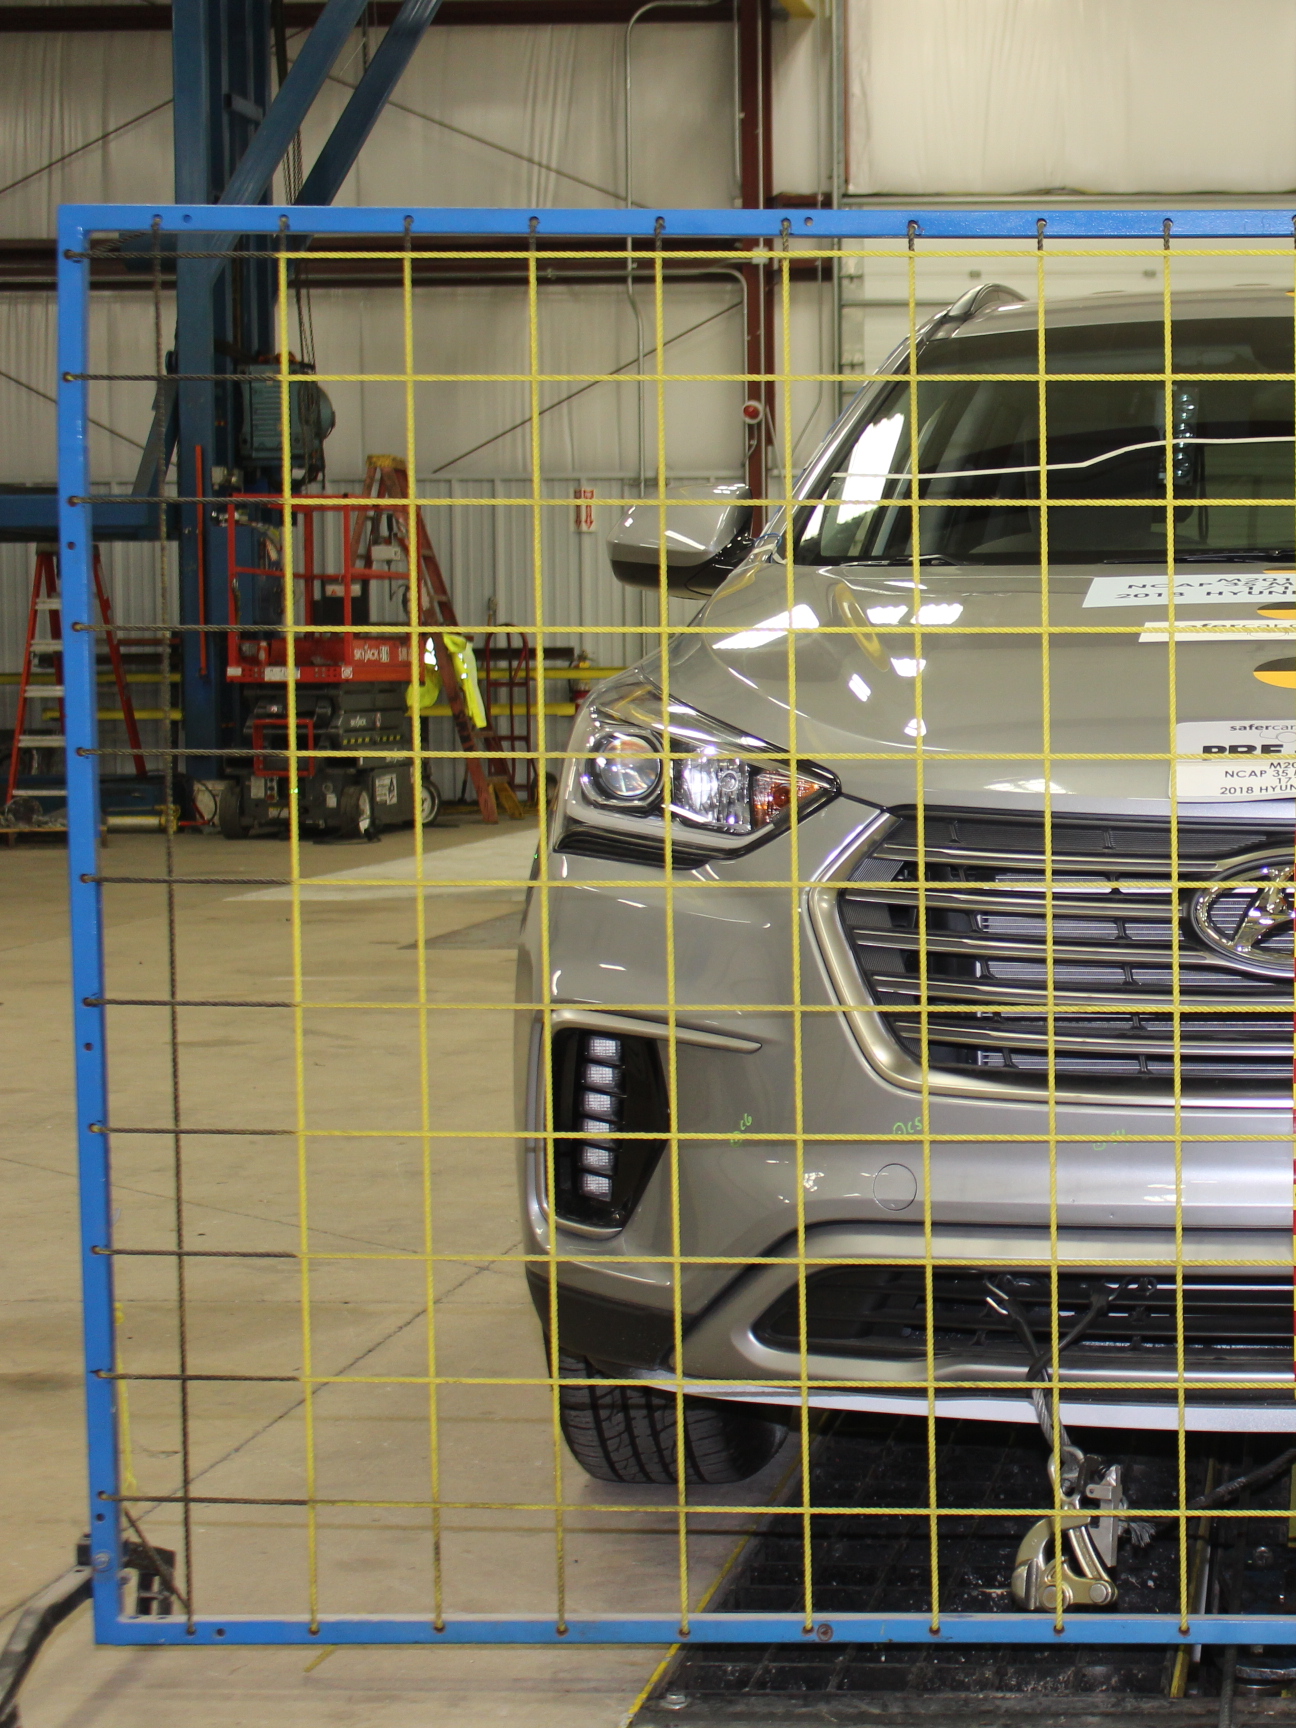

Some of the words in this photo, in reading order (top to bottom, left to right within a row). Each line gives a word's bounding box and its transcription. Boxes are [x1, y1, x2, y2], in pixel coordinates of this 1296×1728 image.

[1202, 743, 1283, 761] PRE
[1224, 769, 1267, 778] NCAP
[1272, 769, 1289, 777] 35
[1219, 786, 1254, 795] 2018
